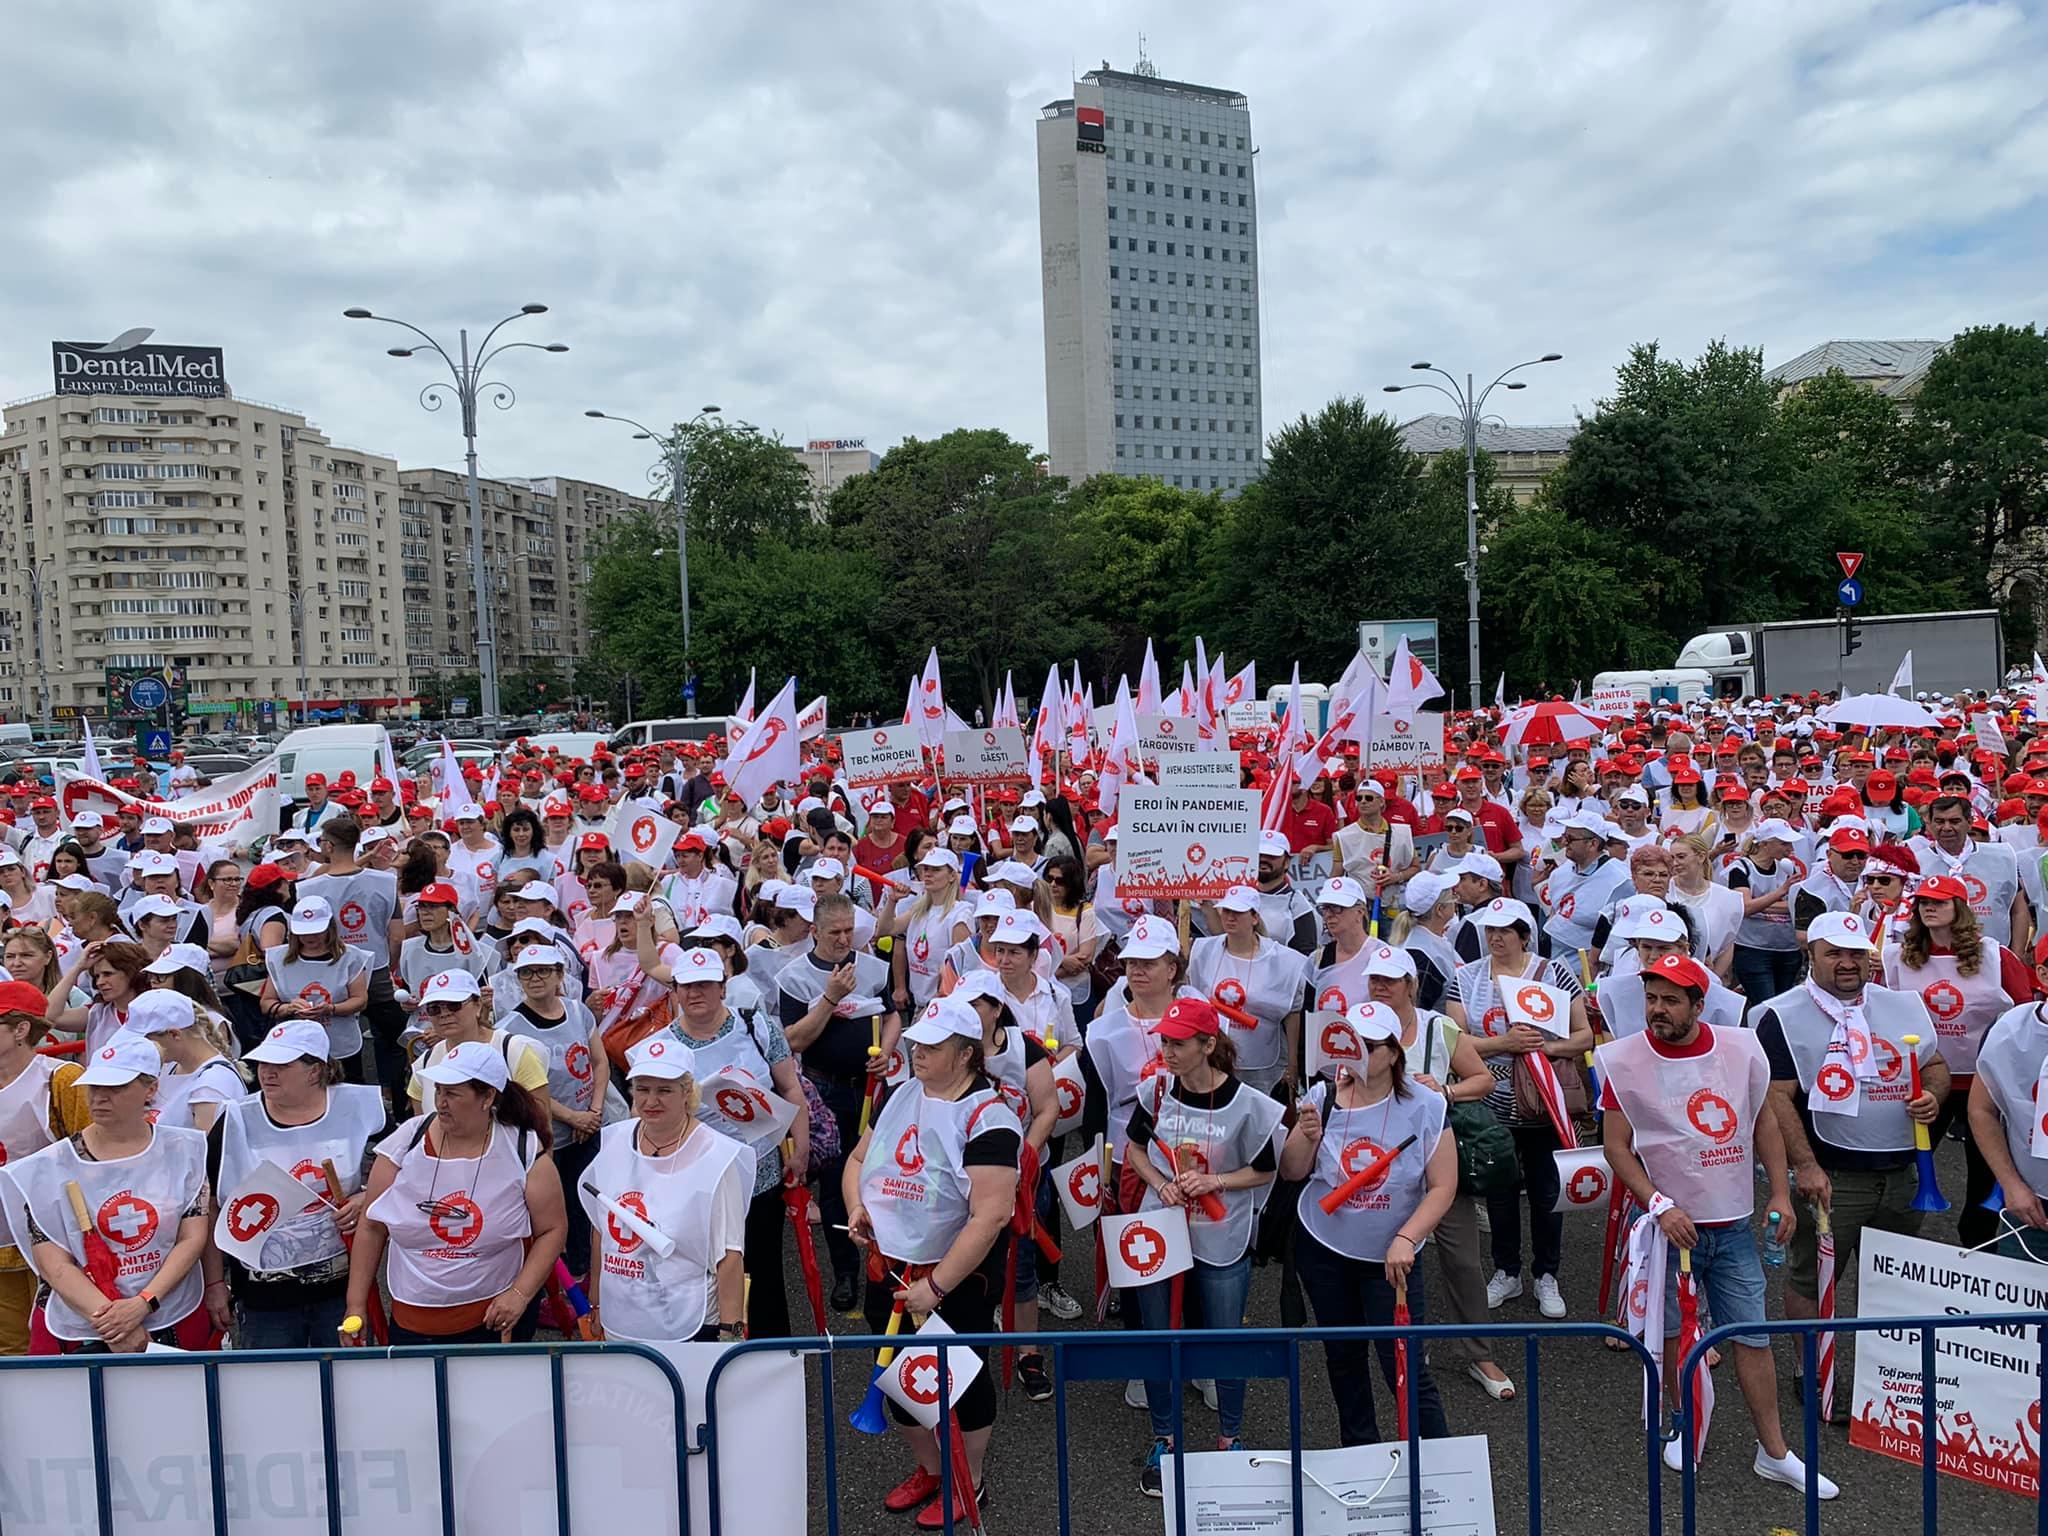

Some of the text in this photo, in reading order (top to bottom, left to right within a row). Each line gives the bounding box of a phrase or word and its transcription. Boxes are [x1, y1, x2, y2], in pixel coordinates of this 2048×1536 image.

[1077, 141, 1106, 153] BRD
[57, 351, 220, 379] DentalMed
[60, 378, 221, 394] Luxury Dental Clinic
[808, 439, 864, 449] FIRSTBANK
[1593, 690, 1631, 700] SANITAS
[851, 750, 916, 765] TBC MOROENI
[1166, 766, 1183, 775] AVEM
[1183, 765, 1216, 774] ASISTENTE
[1134, 796, 1248, 812] EROI ÎN PANDEMIE,
[1132, 819, 1247, 833] SCLAVI ÎN CIVILIE!
[1126, 888, 1164, 897] ÎMPREUNĂ
[1165, 888, 1195, 897] SUNTEM
[1196, 888, 1210, 897] MAI
[1700, 1145, 1744, 1160] SANITAS
[883, 1178, 925, 1193] SANITAS
[1873, 1254, 1925, 1283] NE-AM
[1930, 1267, 1991, 1298] LUPTAT
[1995, 1282, 2019, 1303] CU
[1908, 1332, 2029, 1375] PLITICIENII
[1882, 1381, 1923, 1395] SANITA
